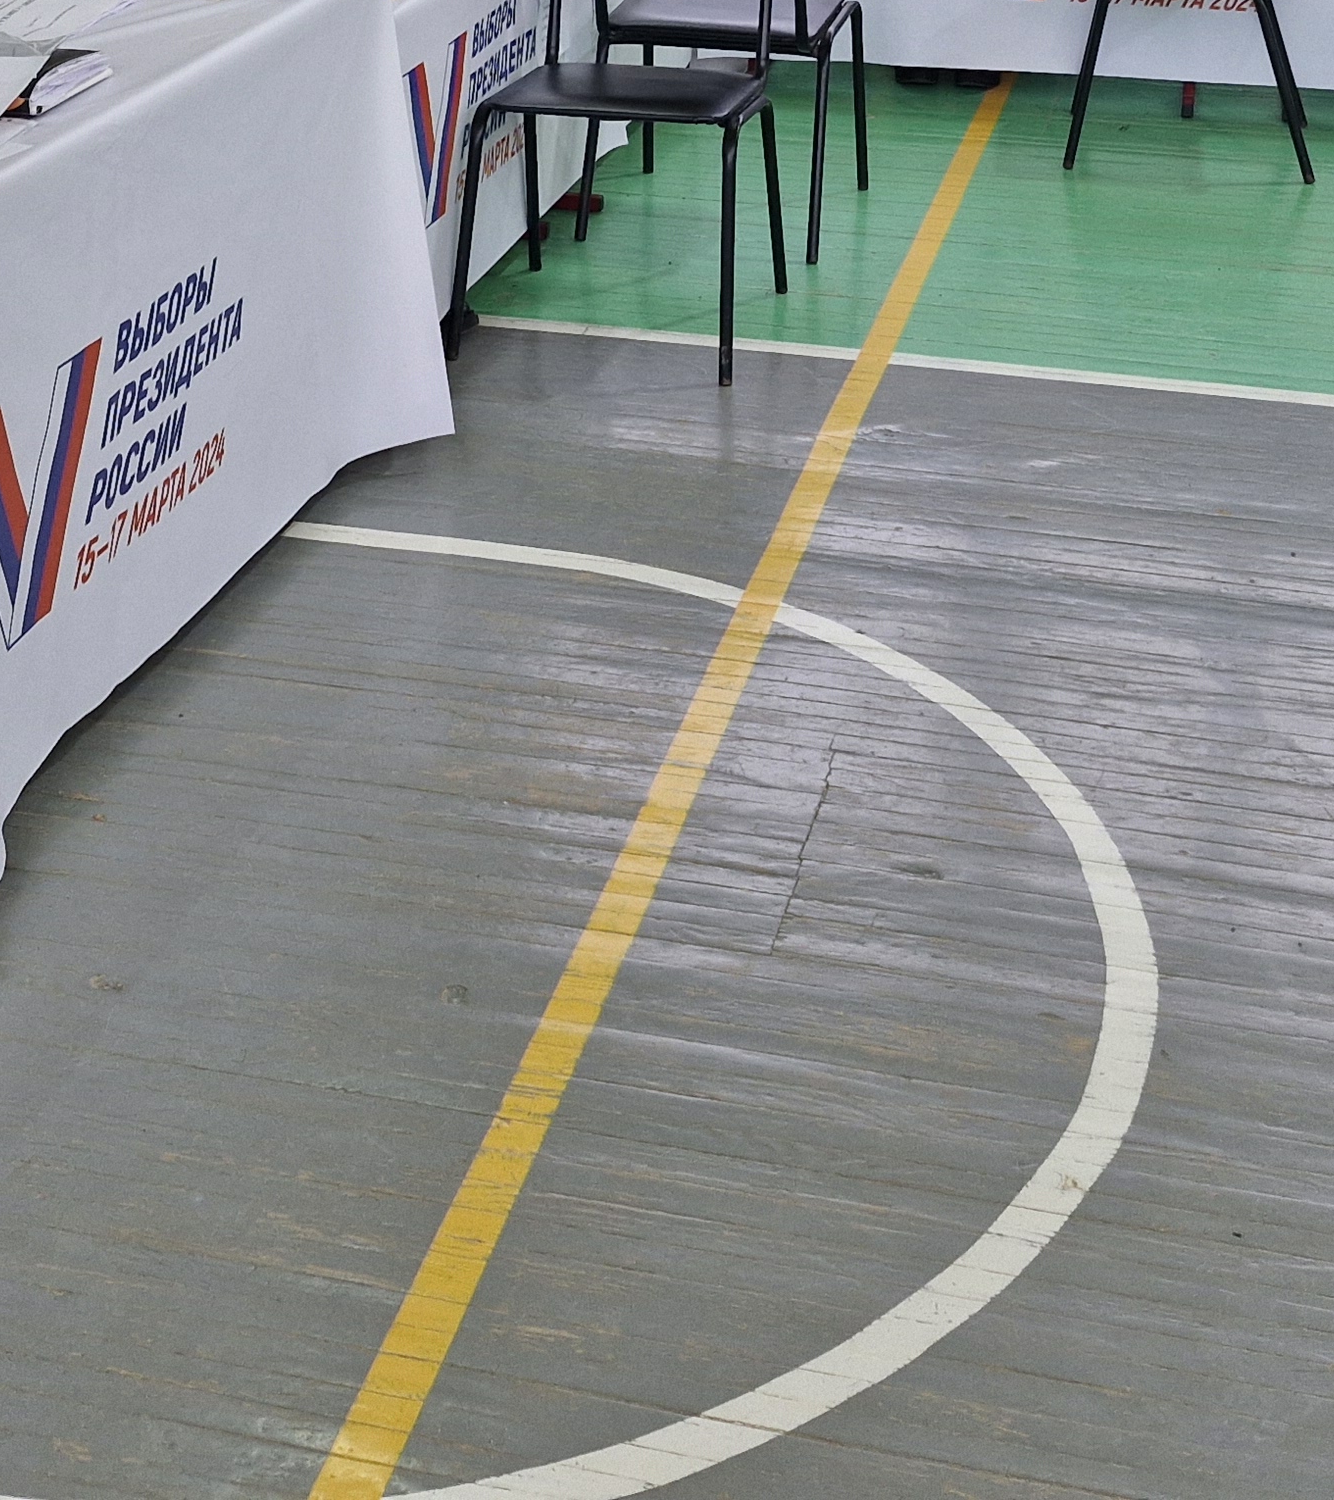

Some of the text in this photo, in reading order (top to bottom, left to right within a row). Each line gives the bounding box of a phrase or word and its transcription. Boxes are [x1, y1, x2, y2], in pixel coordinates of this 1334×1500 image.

[467, 26, 537, 109] ПРЕЗИДЕНТА
[481, 133, 510, 183] МАРТА
[100, 297, 243, 449] ПРЕЗИДЕНТА
[113, 256, 217, 375] ВЫБОРЫ
[85, 402, 187, 526] РОССИИ
[127, 461, 187, 547] МАРТА
[188, 427, 225, 494] 2024
